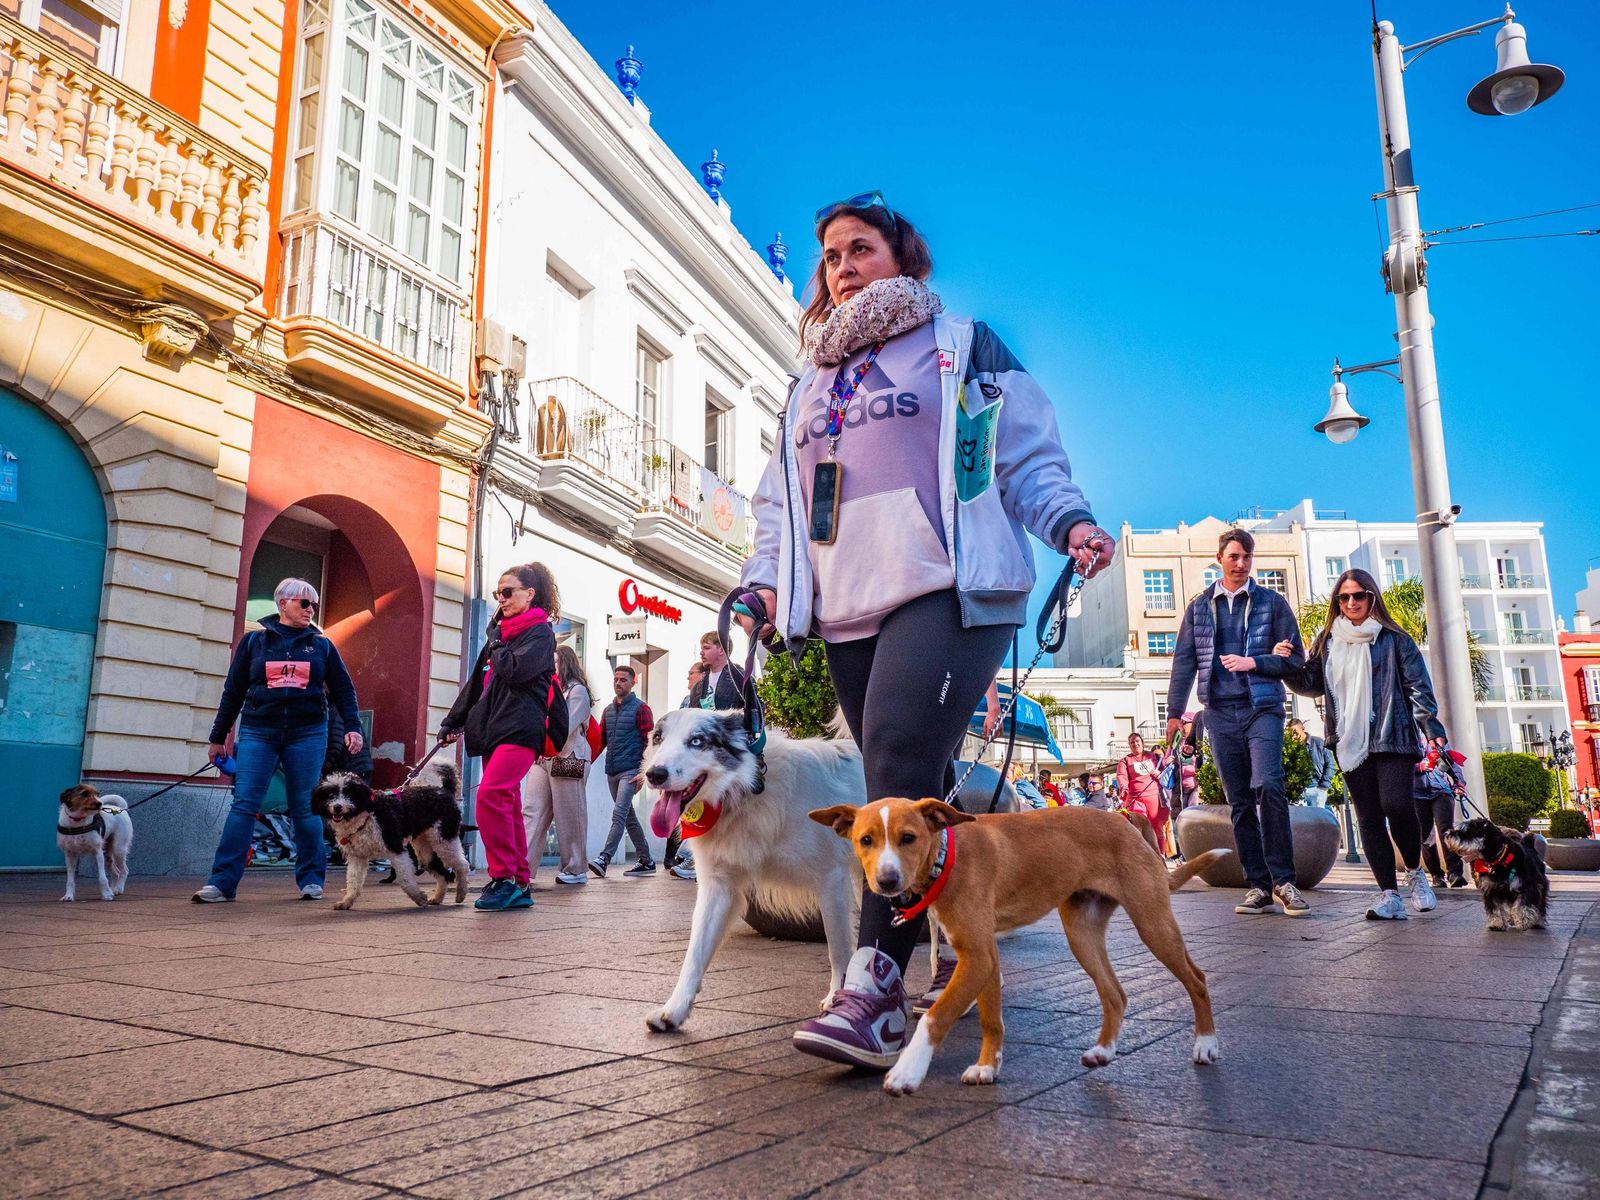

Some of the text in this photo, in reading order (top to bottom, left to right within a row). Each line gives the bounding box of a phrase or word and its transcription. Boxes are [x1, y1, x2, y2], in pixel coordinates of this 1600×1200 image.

[795, 392, 920, 449] addas
[615, 630, 641, 641] Lowi
[281, 664, 297, 678] 47
